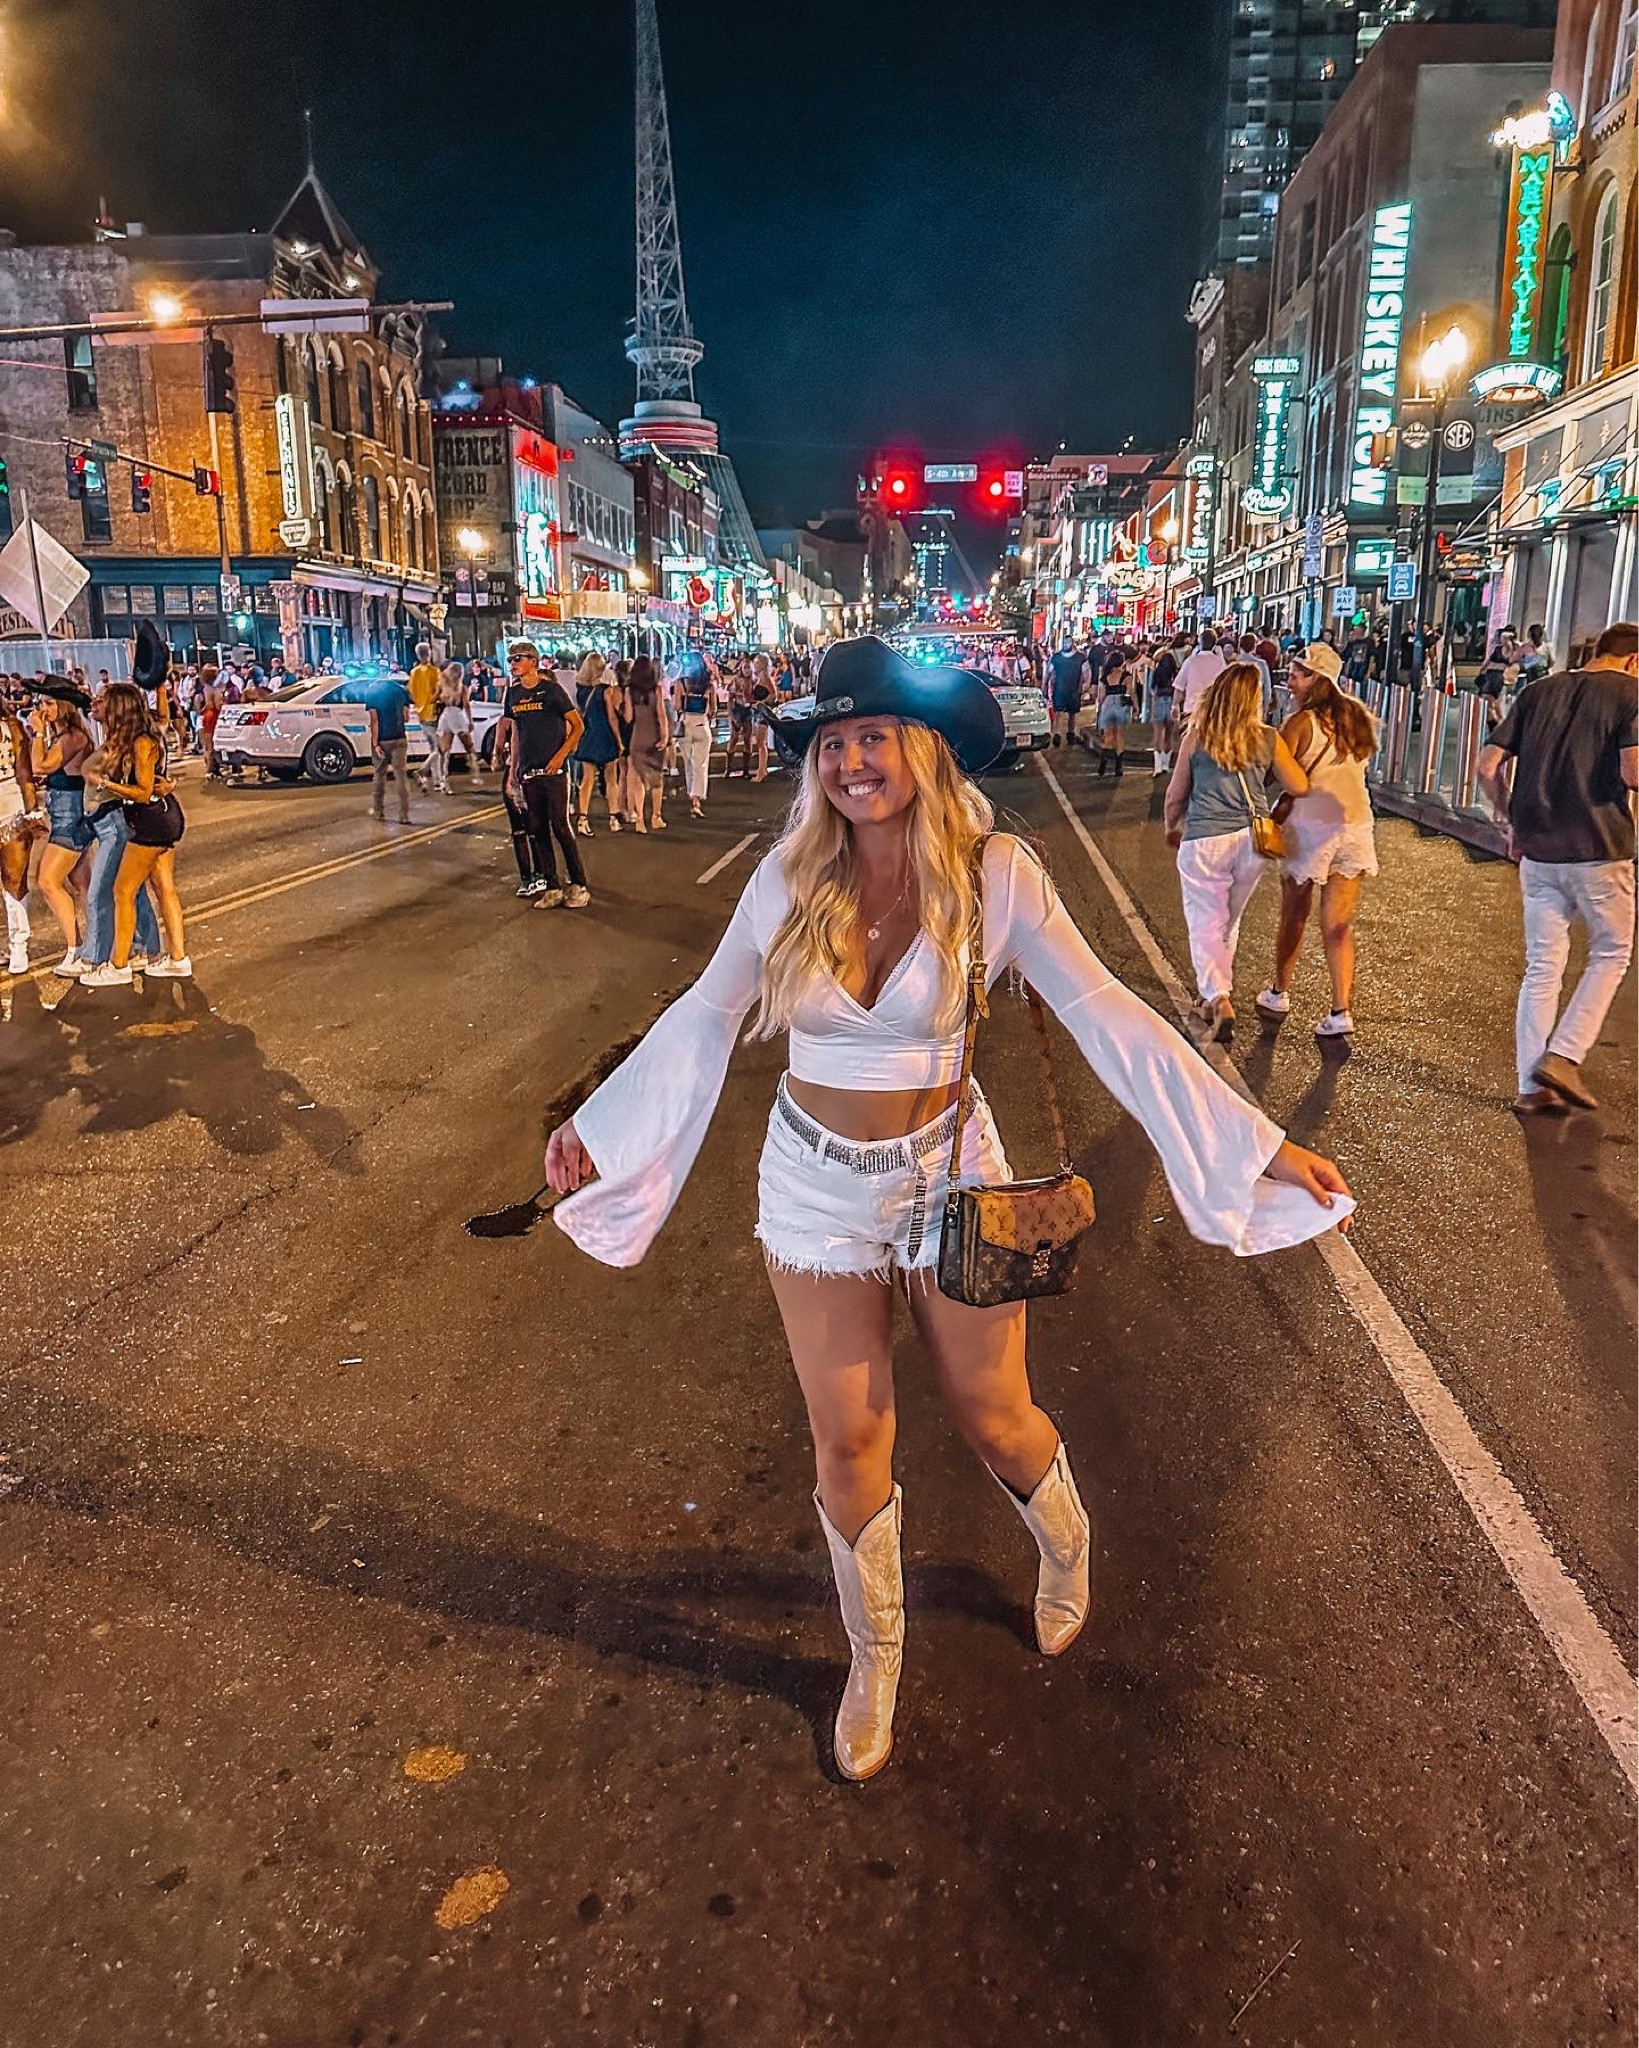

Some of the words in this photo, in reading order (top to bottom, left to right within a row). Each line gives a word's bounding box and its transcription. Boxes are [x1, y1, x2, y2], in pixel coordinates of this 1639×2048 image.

[1360, 202, 1413, 398] WHISKEY
[436, 435, 503, 466] RENCE
[1261, 381, 1285, 493] WHISKEY
[1350, 406, 1394, 506] ROW
[1447, 423, 1471, 447] SEC
